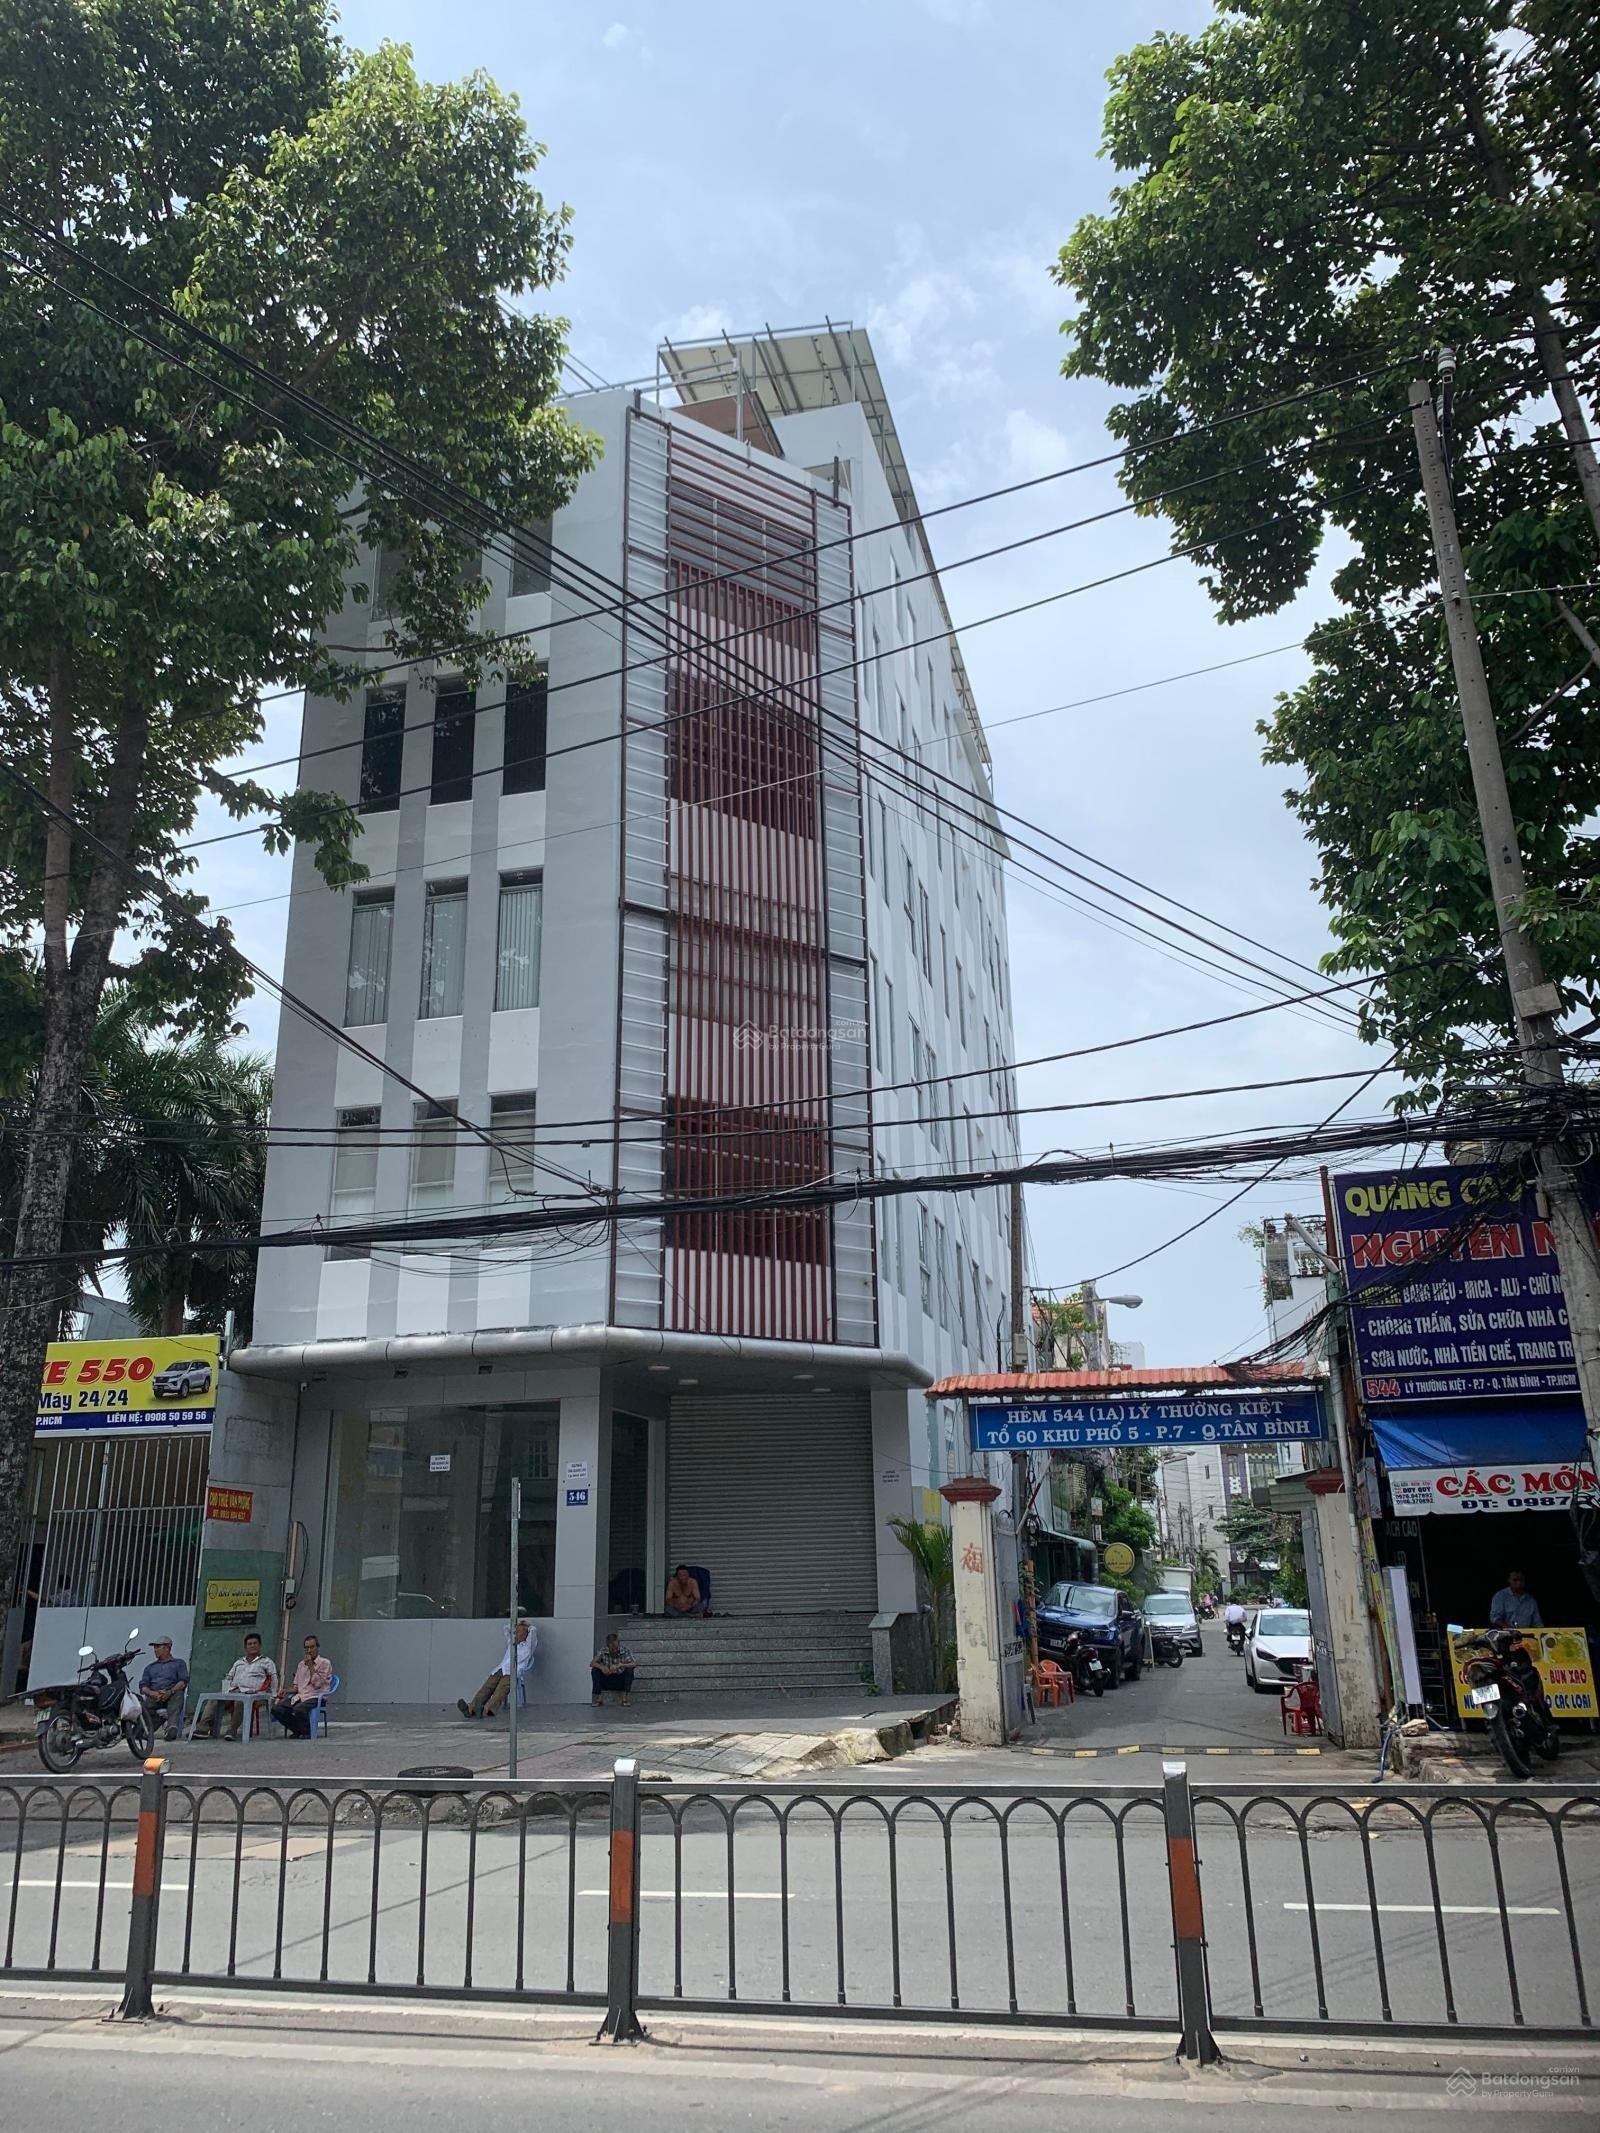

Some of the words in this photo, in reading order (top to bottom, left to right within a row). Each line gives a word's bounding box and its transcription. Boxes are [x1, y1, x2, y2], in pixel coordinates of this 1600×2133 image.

[1464, 1279, 1493, 1299] MICA
[1500, 1277, 1521, 1297] ALU
[1528, 1272, 1551, 1296] CHỮ
[1414, 1310, 1457, 1334] THẤM,
[1458, 1308, 1487, 1331] SỬA
[1488, 1308, 1526, 1330] CHỮA
[1526, 1305, 1557, 1327] NHÀ
[1371, 1349, 1396, 1367] SƠN
[1397, 1345, 1433, 1367] NƯỚC,
[1434, 1343, 1460, 1364] NHÀ
[1460, 1340, 1488, 1363] TIỀN
[1488, 1338, 1517, 1362] CHẾ,
[1517, 1341, 1557, 1360] TRANG
[76, 1356, 155, 1385] 550
[1366, 1379, 1401, 1398] 544
[1404, 1380, 1414, 1394] LÝ
[1448, 1377, 1466, 1393] KIỆT
[1473, 1379, 1485, 1390] P.7
[1546, 1374, 1577, 1387] TP.HCM
[39, 1392, 72, 1411] Máy
[78, 1389, 129, 1408] 24/24
[1053, 1408, 1084, 1422] 544
[1128, 1403, 1152, 1420] LÝ
[1156, 1401, 1233, 1419] THƯỜNG
[106, 1412, 127, 1424] LIÊN
[128, 1412, 143, 1425] HỆ:
[145, 1413, 167, 1422] 0908
[168, 1412, 180, 1422] 50
[182, 1412, 194, 1421] 59
[195, 1411, 207, 1420] 56
[987, 1423, 1010, 1445] TỔ
[1016, 1430, 1038, 1444] 60
[1042, 1429, 1080, 1443] KHU
[1085, 1422, 1122, 1442] PHỐ
[1128, 1426, 1139, 1440] 5
[1156, 1425, 1184, 1440] P.7
[1263, 1418, 1311, 1436] BÌNH
[1436, 1469, 1514, 1497] CÁC
[568, 1491, 586, 1501] 546
[1461, 1499, 1499, 1510] ĐT:
[1507, 1496, 1571, 1508] 0987
